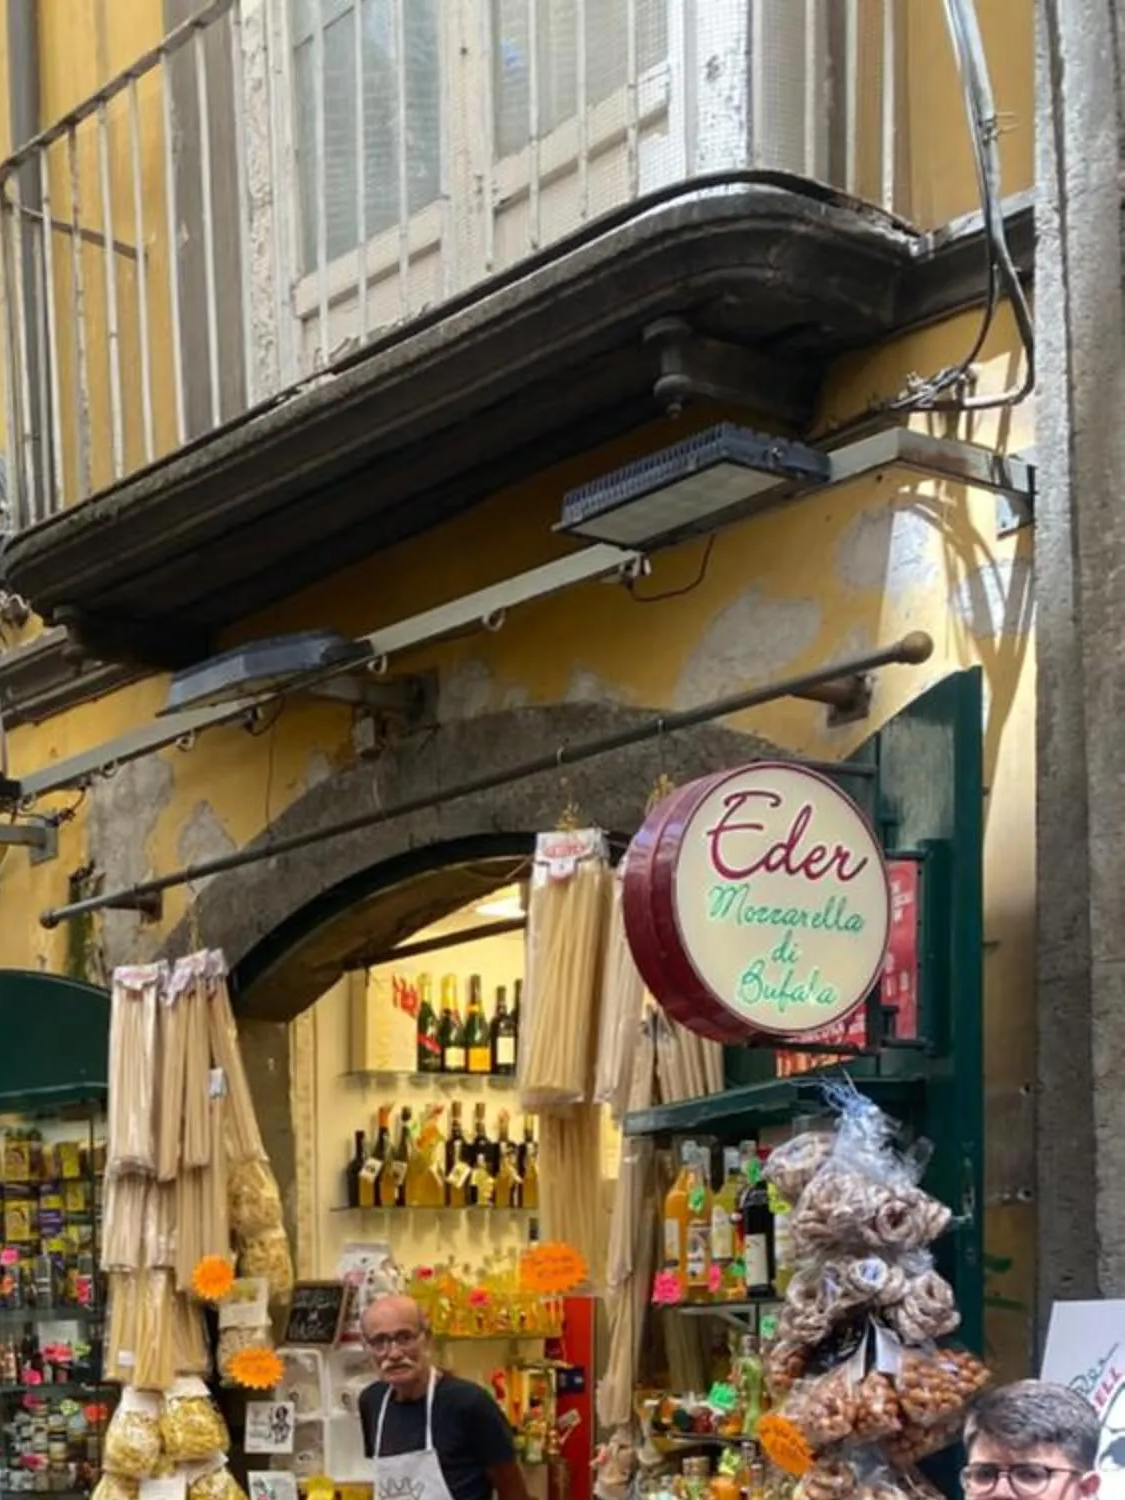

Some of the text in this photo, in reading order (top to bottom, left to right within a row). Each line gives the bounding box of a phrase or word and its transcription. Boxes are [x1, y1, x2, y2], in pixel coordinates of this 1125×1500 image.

[706, 789, 869, 882] Eder
[707, 882, 865, 933] Mozzarella
[770, 928, 800, 965] di
[738, 959, 838, 1013] Bufala
